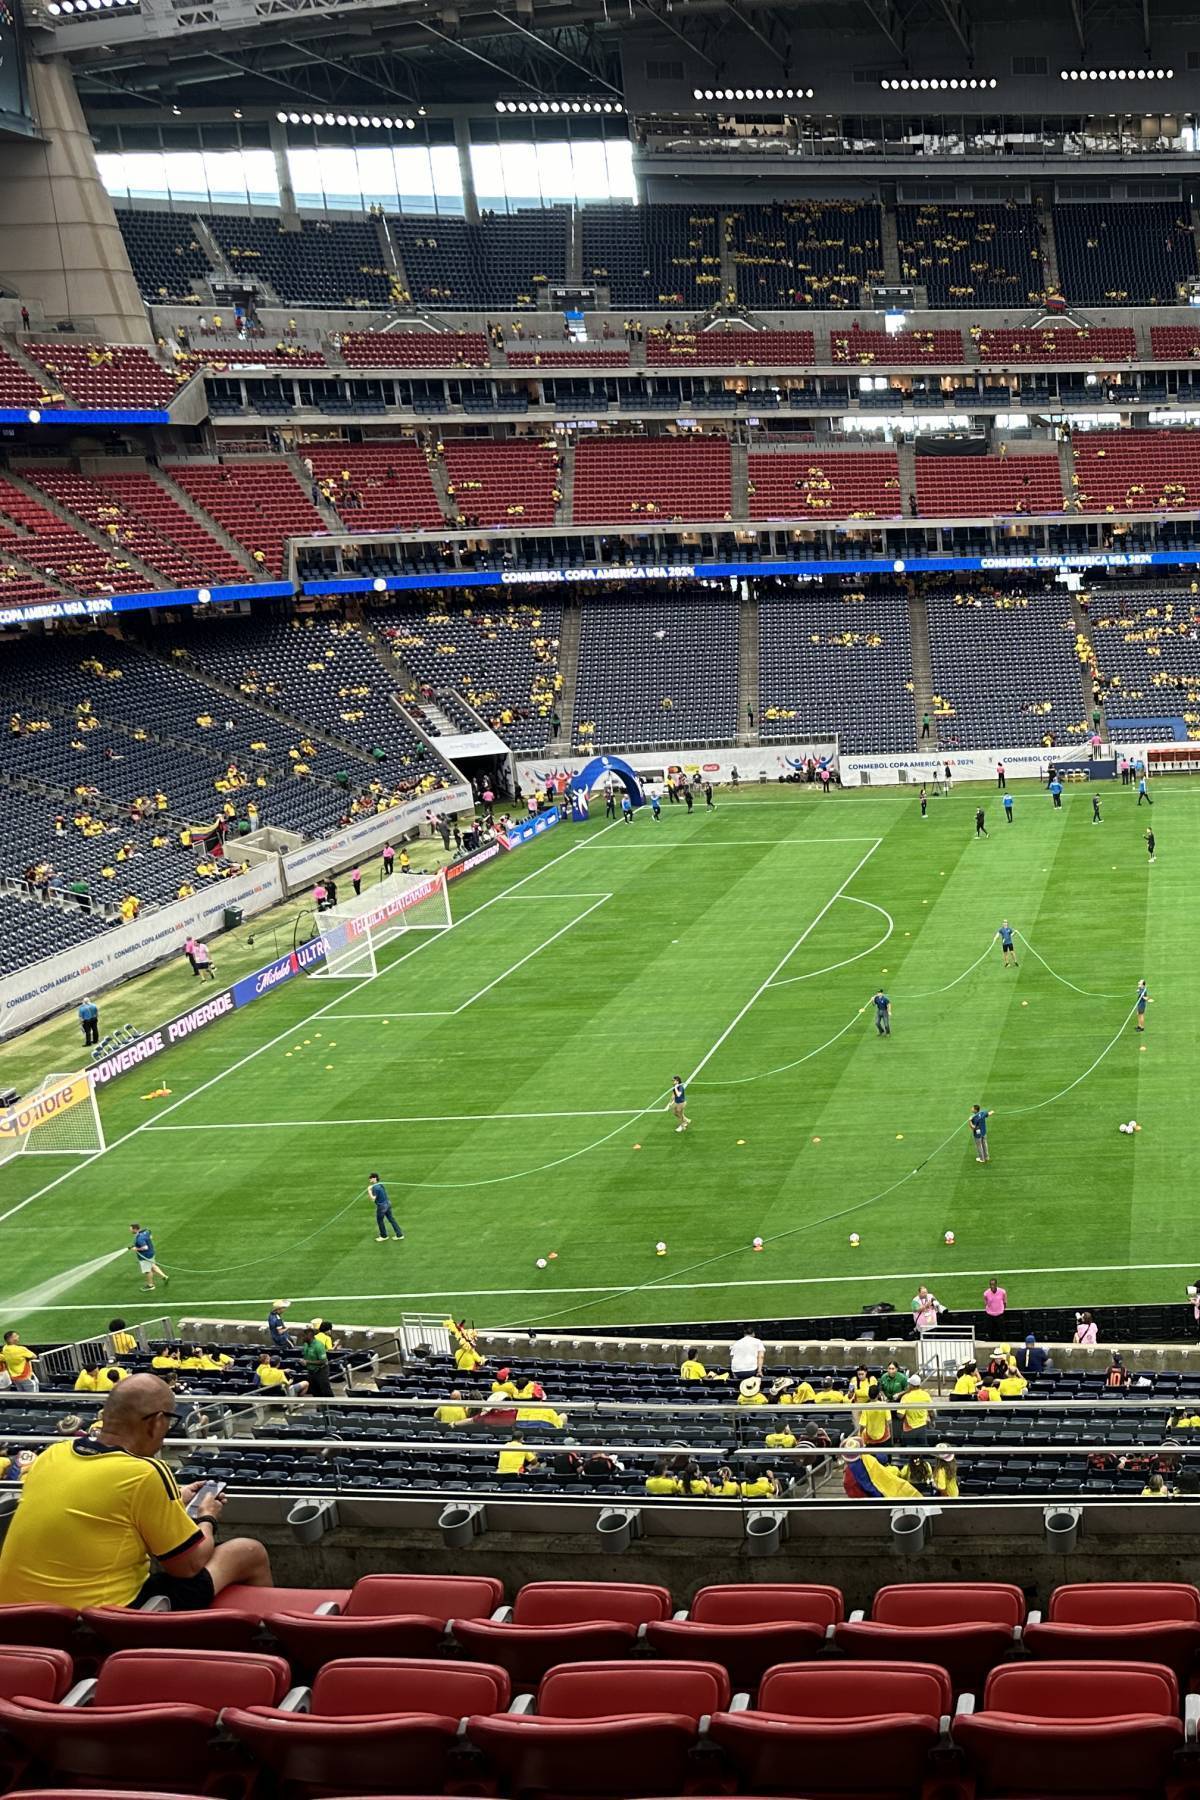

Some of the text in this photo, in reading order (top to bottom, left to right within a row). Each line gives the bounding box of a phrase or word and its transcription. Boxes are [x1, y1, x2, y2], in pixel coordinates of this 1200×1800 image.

[981, 554, 1153, 568] CONMEBOL COPA AMERICA USA 2024
[501, 566, 695, 583] CONMEBOL COPA AMERICA USA 2024
[0, 608, 24, 624] COPA
[64, 601, 86, 615] USA
[86, 598, 113, 612] 2024
[848, 762, 888, 770] CONMEBOL
[910, 760, 941, 768] AMERICA
[1003, 756, 1041, 764] CONMEBOL
[114, 917, 195, 959] CONMEBOL COPA AMERICA USA 2024
[297, 937, 331, 967] ULTRA
[6, 959, 105, 1009] CONMEBOL COPA AMERICA USA 2024
[168, 992, 234, 1042] POWERADE
[89, 1031, 165, 1088] POWERADE
[1110, 1372, 1121, 1386] 10
